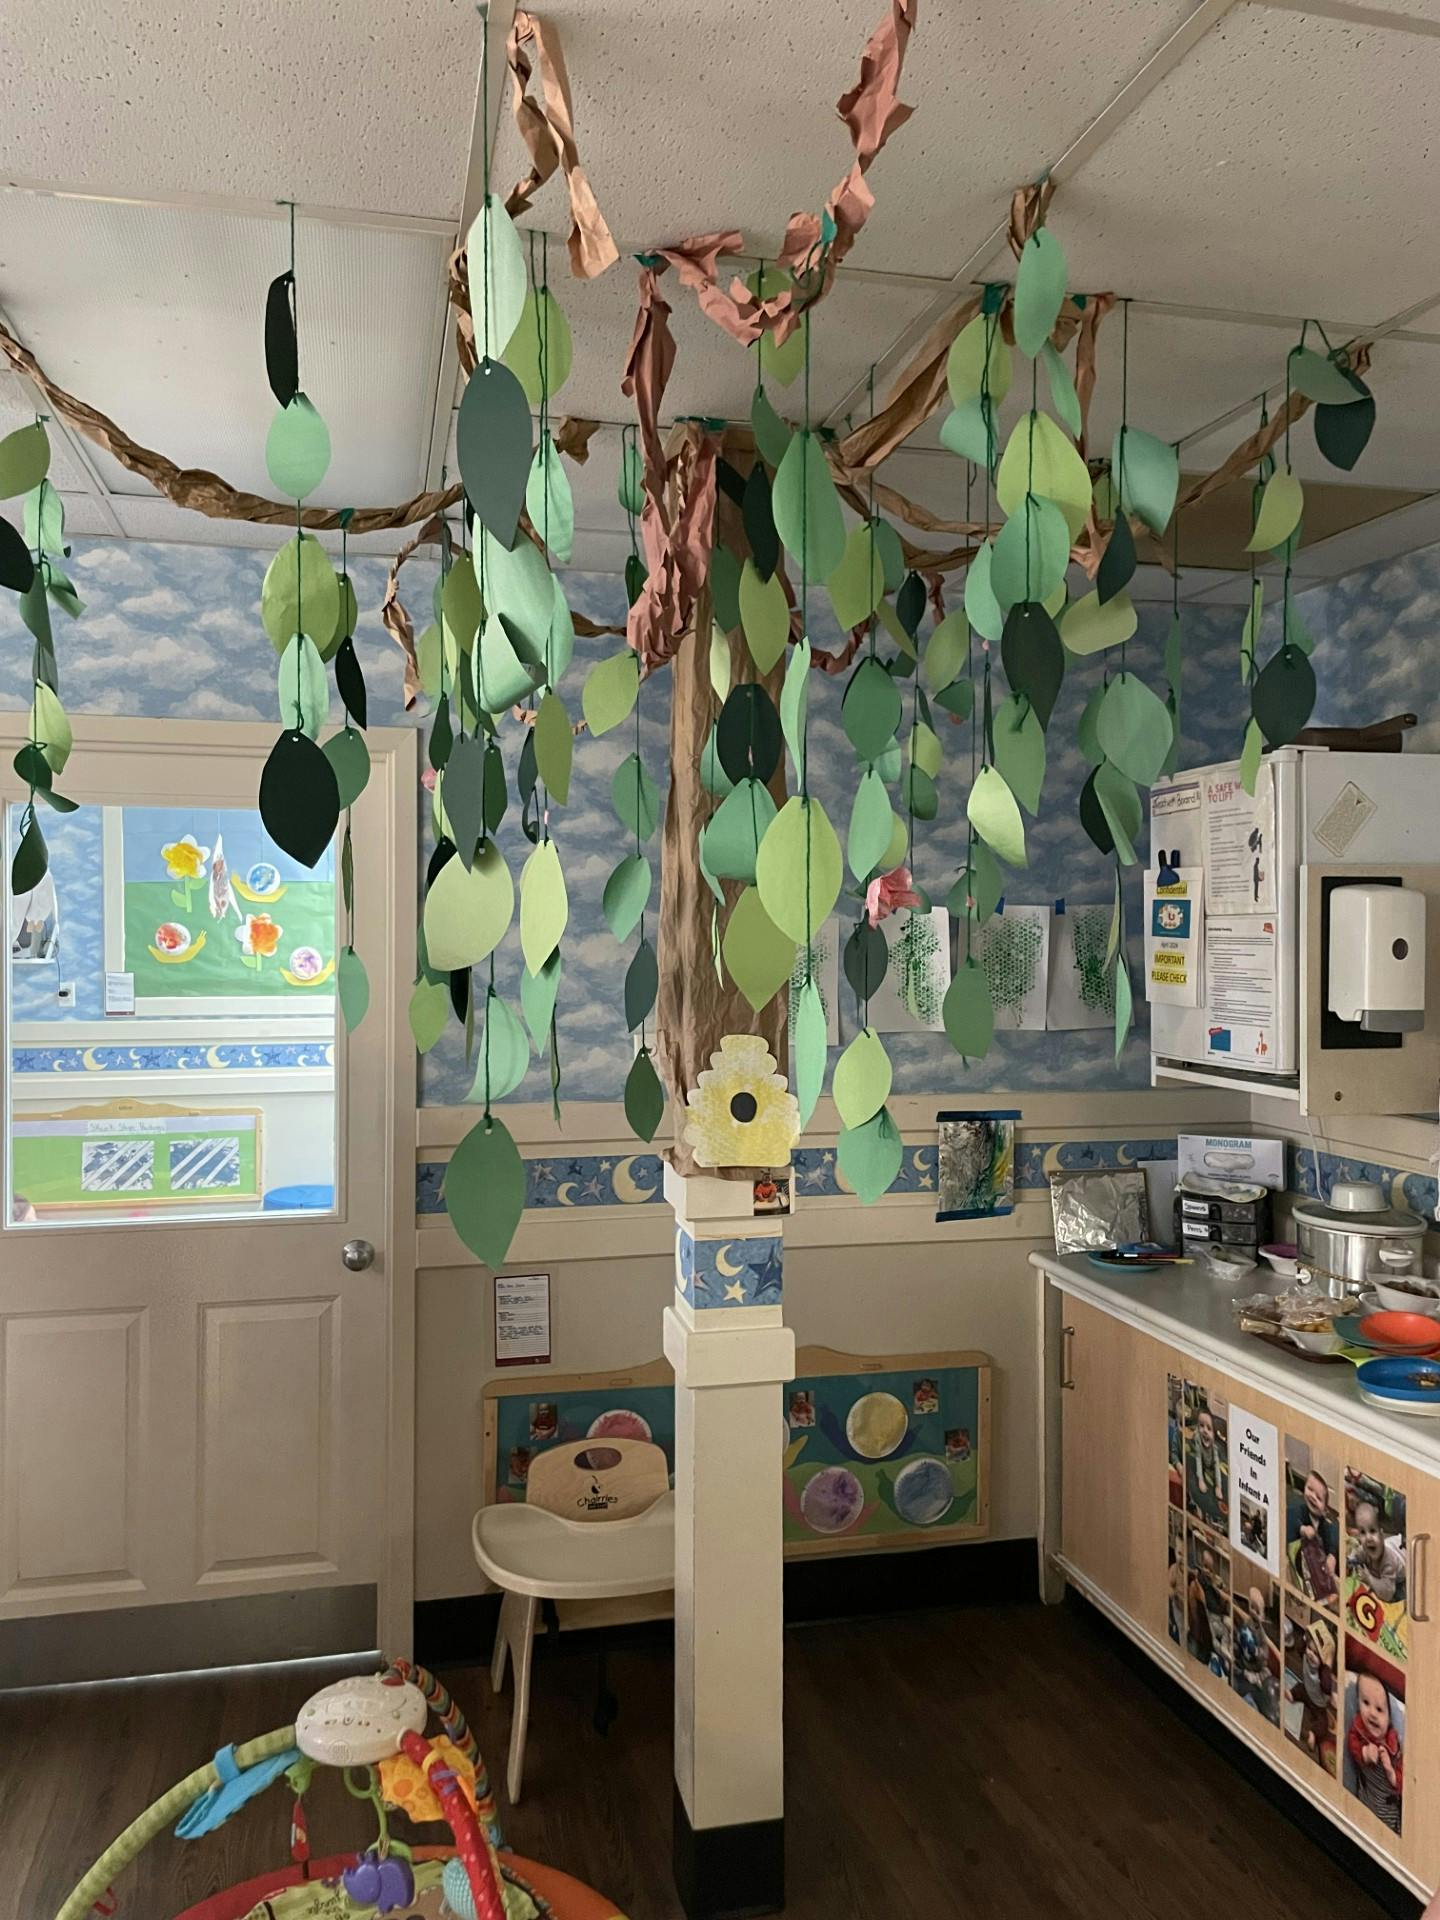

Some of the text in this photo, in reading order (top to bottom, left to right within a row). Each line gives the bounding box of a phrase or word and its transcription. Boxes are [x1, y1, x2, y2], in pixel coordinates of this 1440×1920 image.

[1208, 785, 1213, 794] A
[1215, 782, 1233, 793] SAFE
[1208, 791, 1233, 804] TO LIFT
[1154, 953, 1185, 966] IMPORTANT
[1151, 970, 1187, 984] PLEASE CHECK
[1205, 1138, 1252, 1149] MONOGRAM
[1246, 1428, 1260, 1444] Our
[1240, 1442, 1266, 1467] Friends
[1238, 1477, 1269, 1505] Infant A
